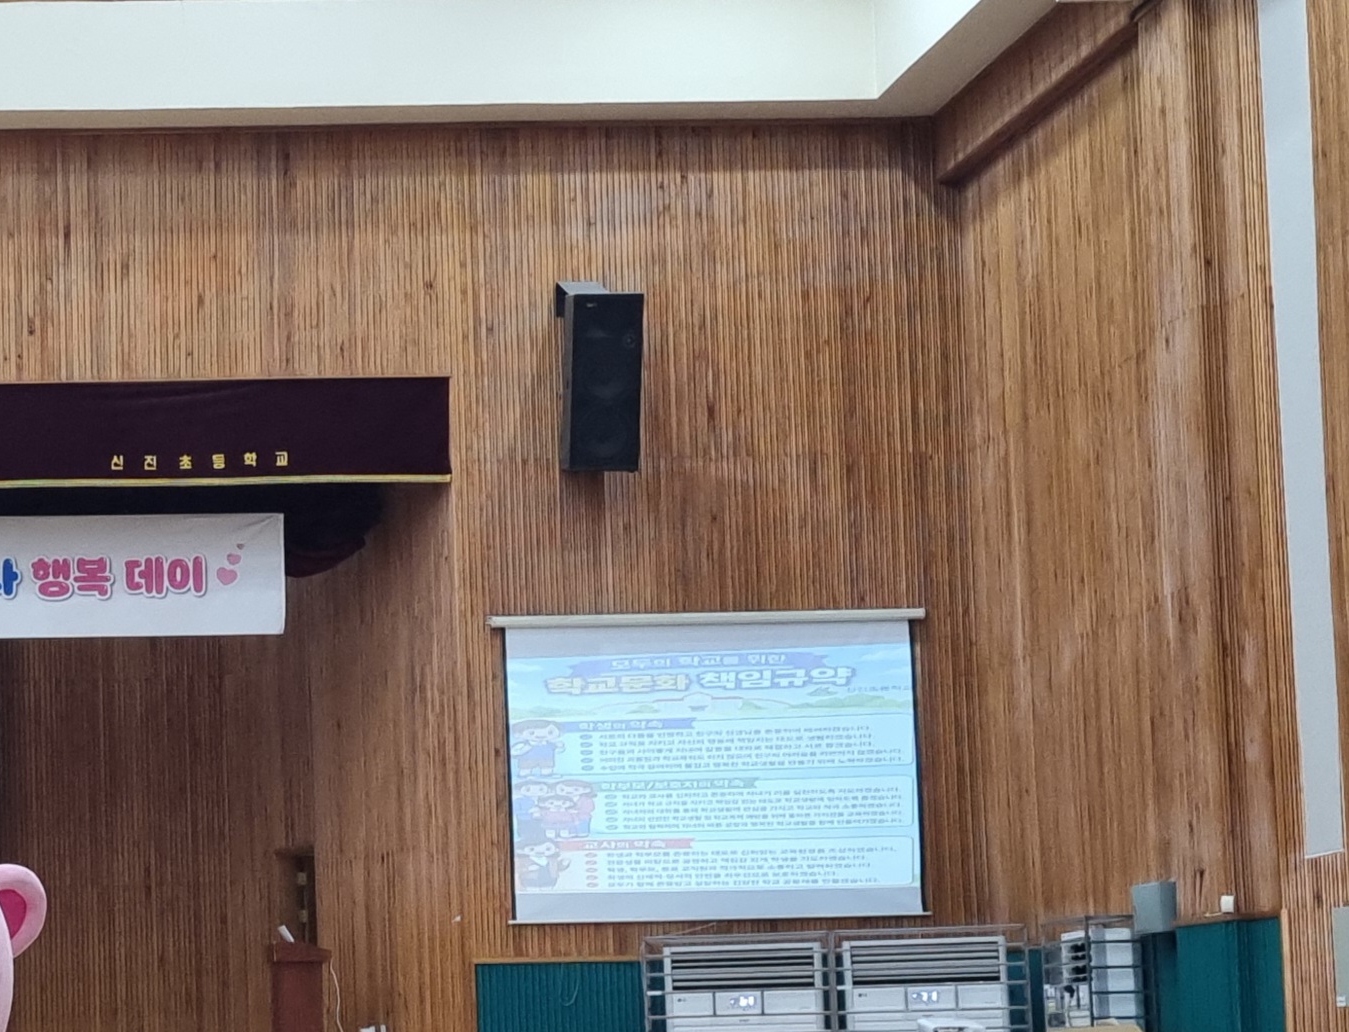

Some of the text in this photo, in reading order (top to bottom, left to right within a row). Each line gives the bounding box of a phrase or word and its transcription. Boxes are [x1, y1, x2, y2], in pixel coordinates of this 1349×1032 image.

[110, 451, 289, 471] 신진초등학교
[30, 556, 112, 598] 행복
[124, 555, 206, 596] 데이
[611, 657, 671, 671] 모두의
[546, 666, 855, 695] 학교문화 책임규약
